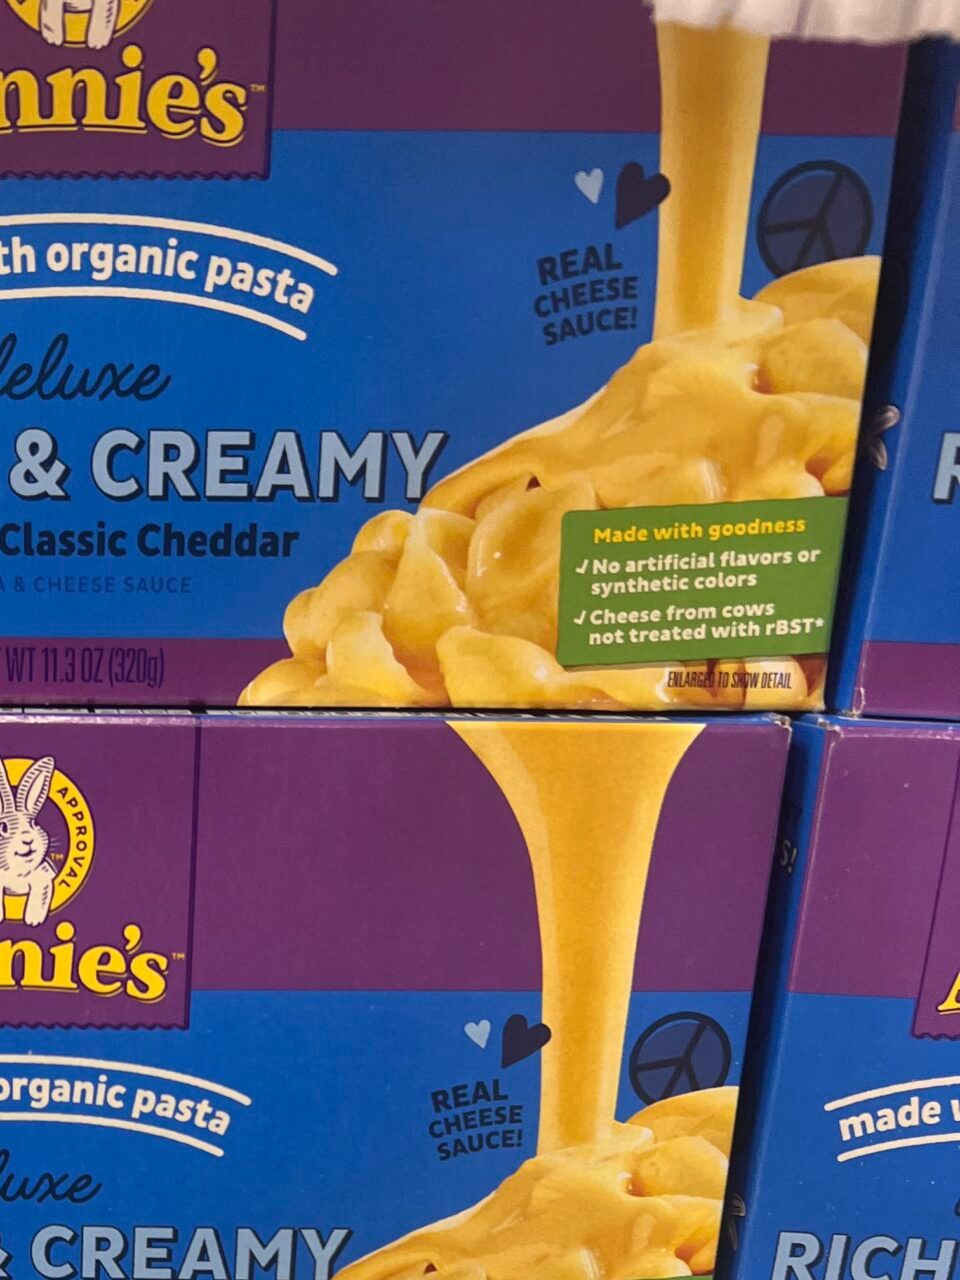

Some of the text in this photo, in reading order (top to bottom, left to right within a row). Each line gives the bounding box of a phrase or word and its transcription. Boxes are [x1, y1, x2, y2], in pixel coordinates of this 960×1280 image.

[45, 237, 196, 281] organic
[205, 255, 316, 314] pasta
[8, 431, 70, 500] &
[90, 429, 448, 502] CREAMY
[56, 785, 88, 891] APPROVAL
[132, 1087, 232, 1137] pasta
[430, 1077, 509, 1113] REAL
[839, 1096, 941, 1141] made
[428, 1104, 523, 1139] CHEESE
[436, 1128, 523, 1162] SAUCE!
